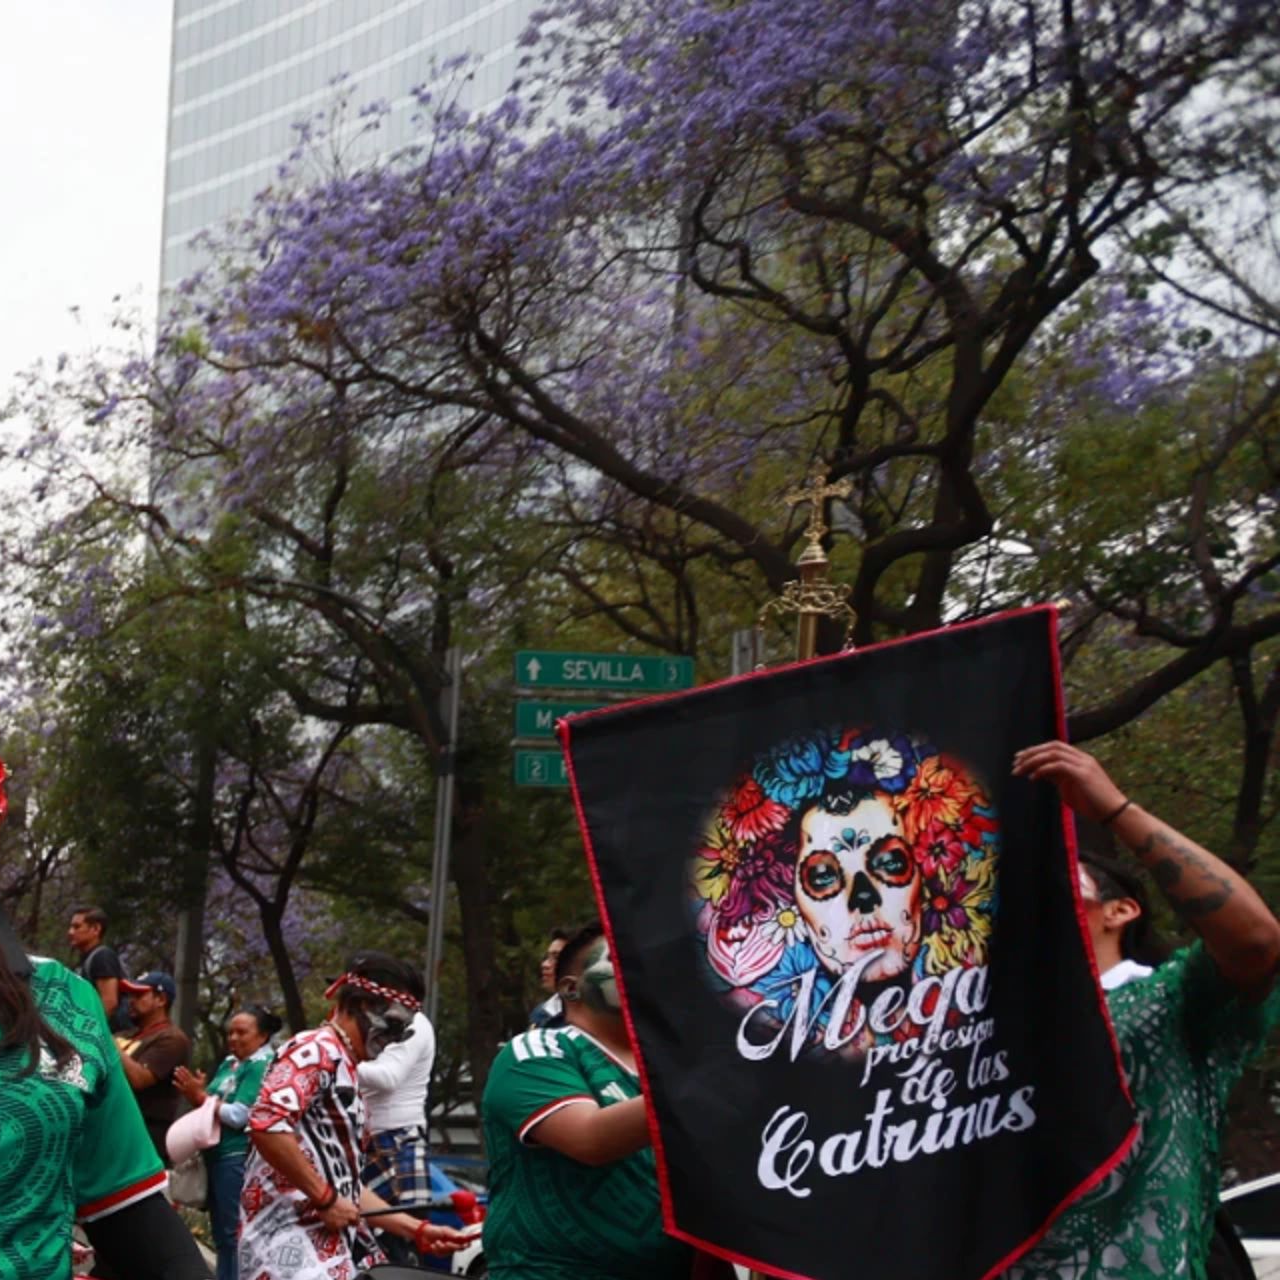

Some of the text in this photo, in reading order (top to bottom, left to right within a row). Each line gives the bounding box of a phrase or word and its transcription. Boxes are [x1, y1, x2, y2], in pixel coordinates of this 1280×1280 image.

[562, 660, 644, 682] SEVILLA
[530, 761, 542, 778] 2
[737, 949, 991, 1077] Mega
[901, 1040, 1010, 1105] de las
[757, 1085, 1037, 1198] Catrinas
